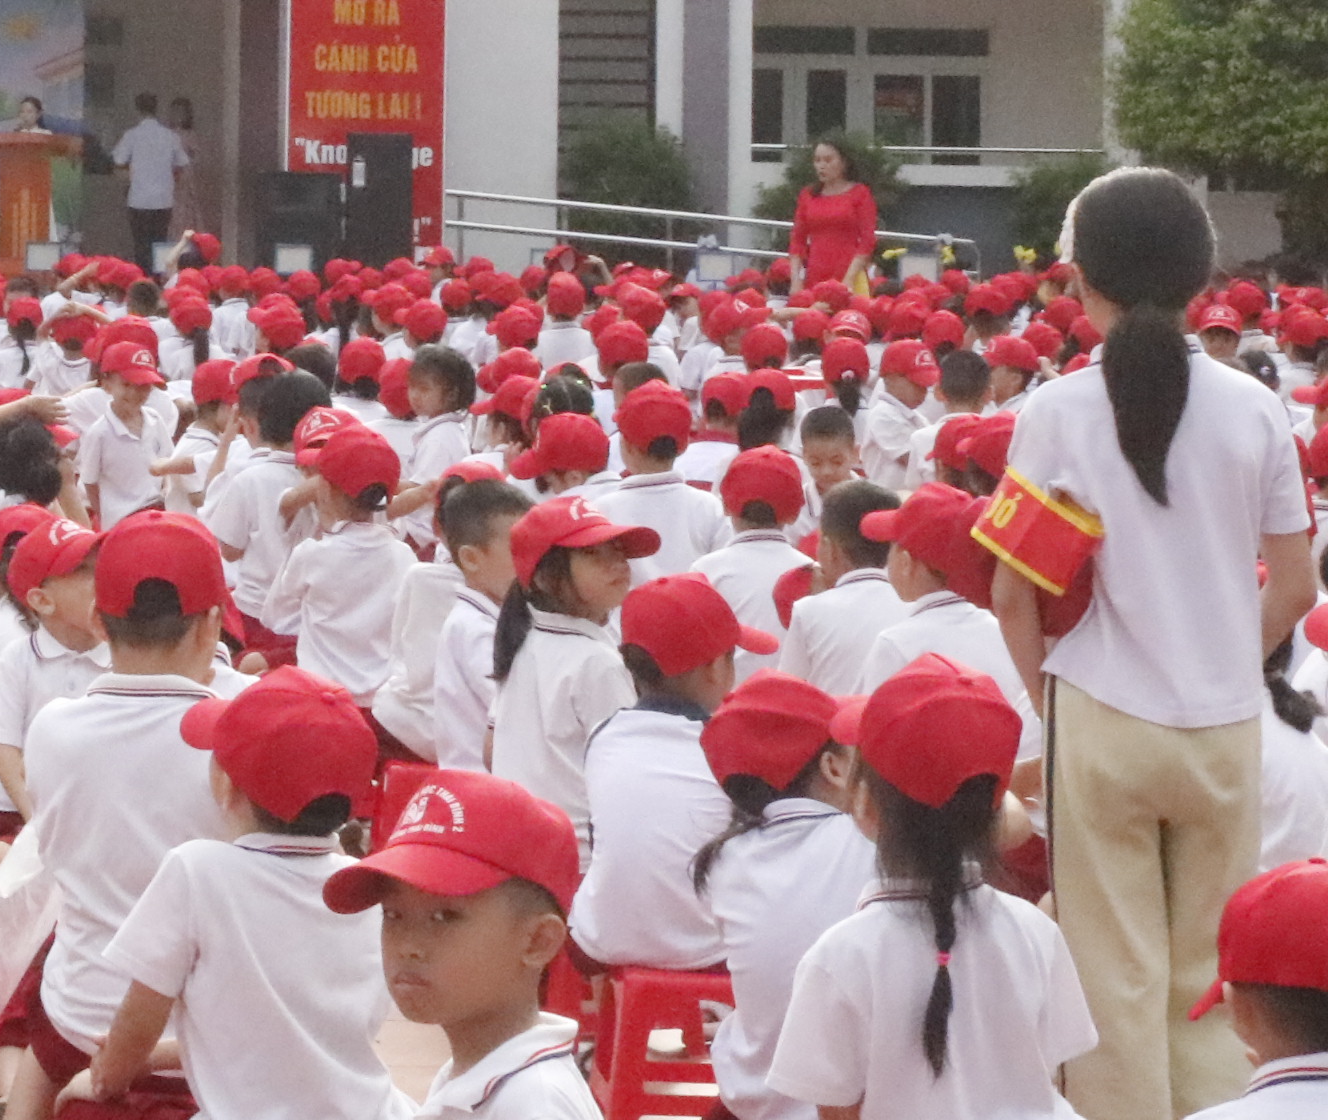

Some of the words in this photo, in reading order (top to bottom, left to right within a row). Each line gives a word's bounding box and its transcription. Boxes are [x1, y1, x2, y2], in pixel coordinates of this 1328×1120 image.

[314, 38, 369, 73] CÁNH
[376, 34, 418, 74] CỬA
[304, 90, 371, 120] TƯƠNG
[378, 92, 410, 120] LAI
